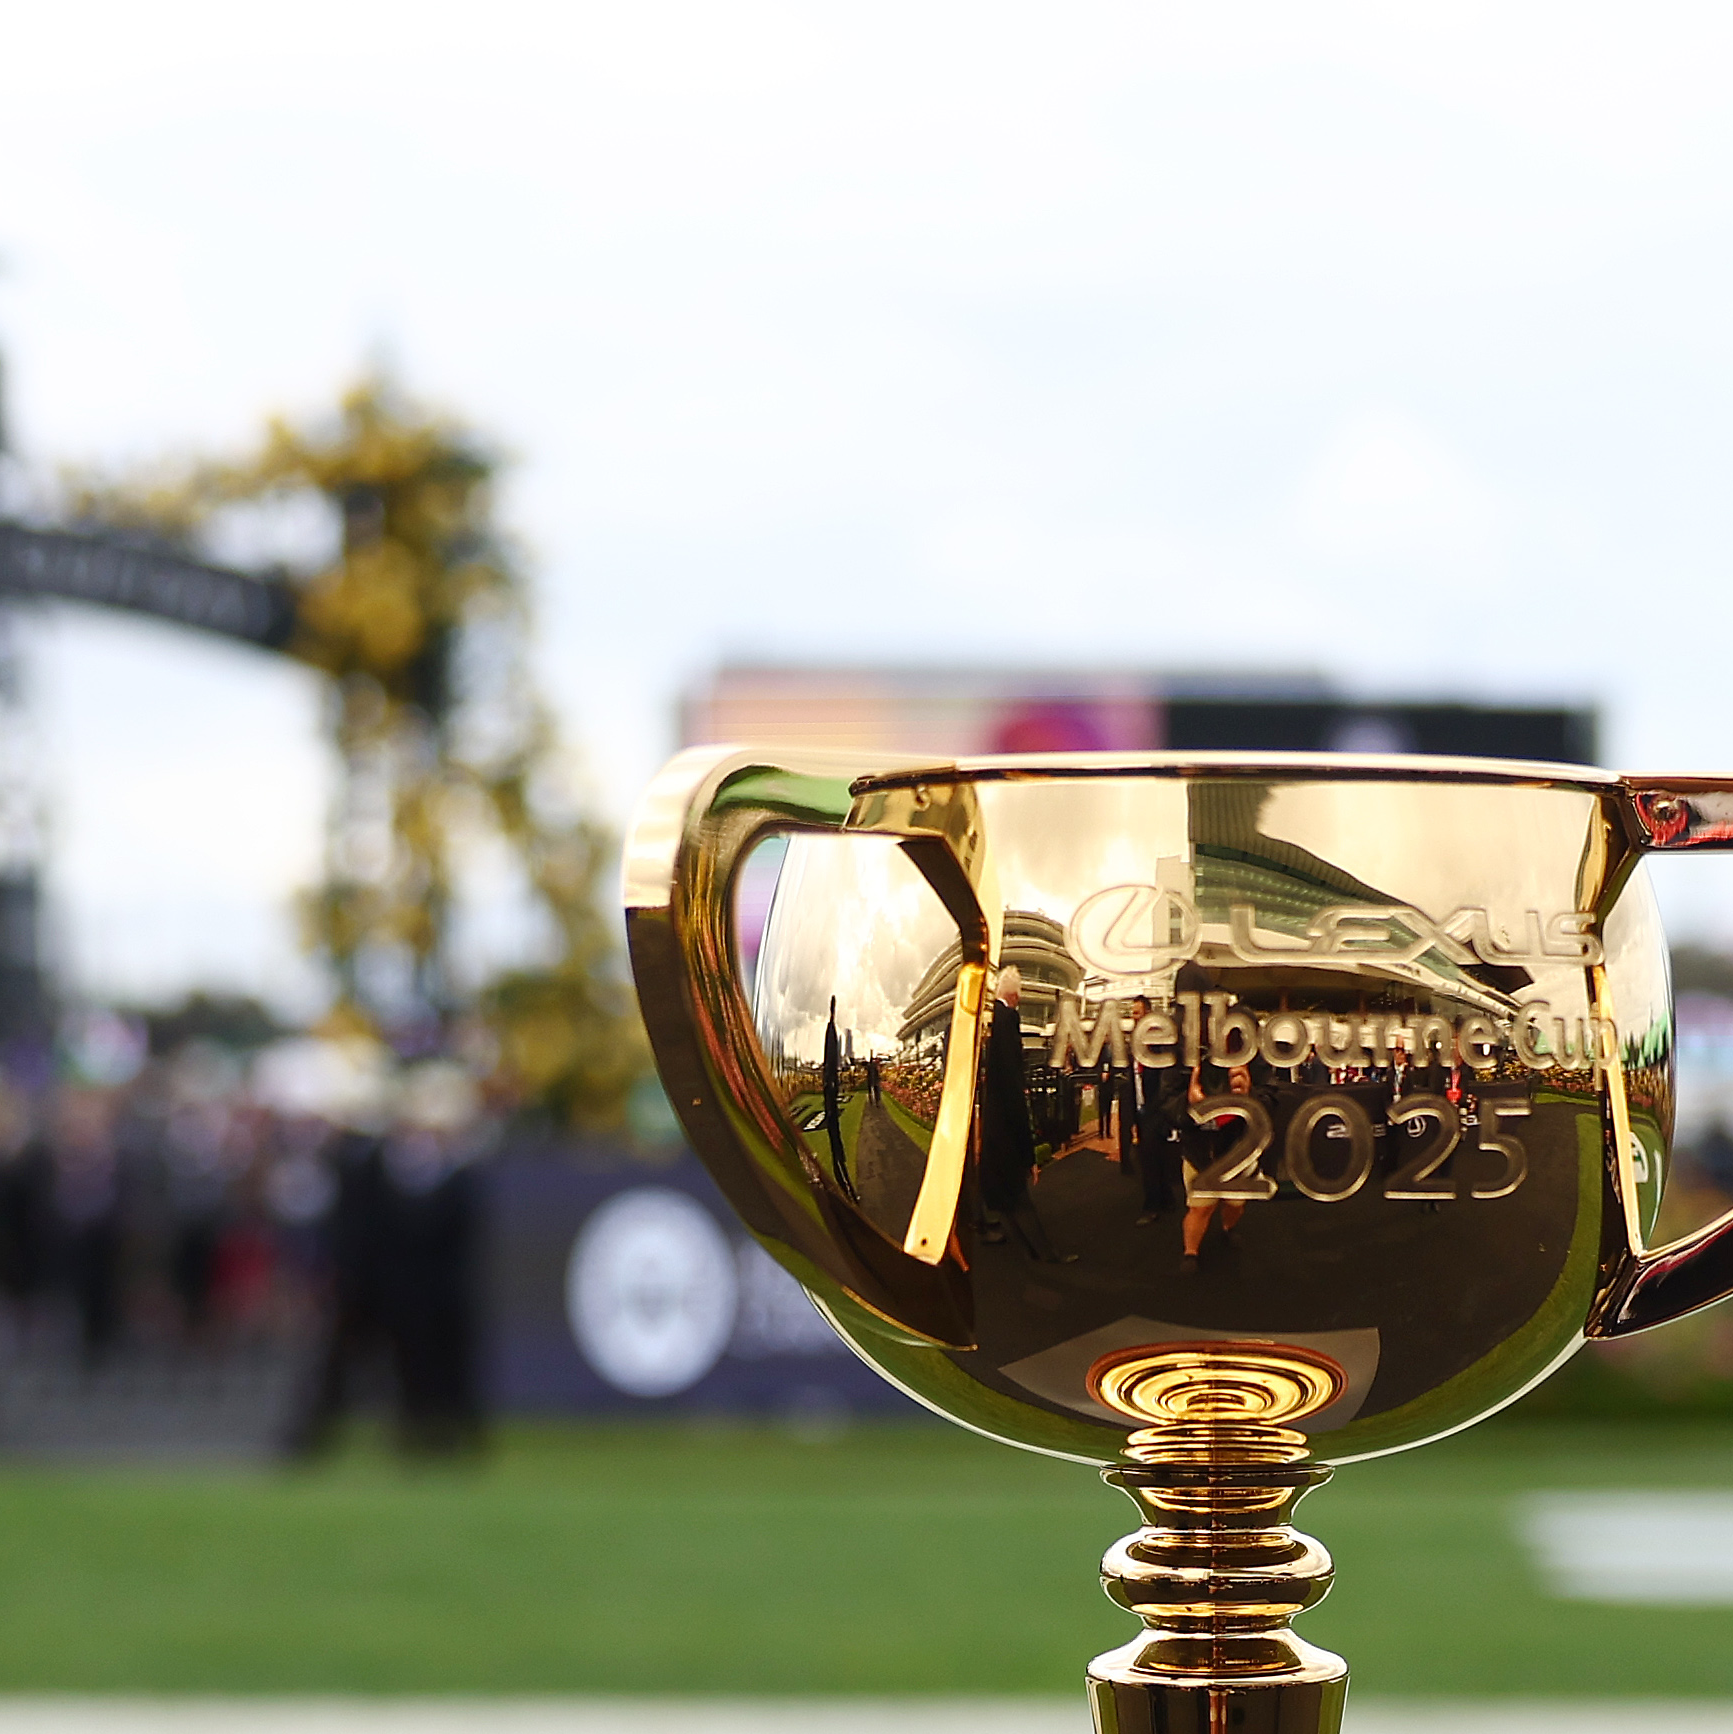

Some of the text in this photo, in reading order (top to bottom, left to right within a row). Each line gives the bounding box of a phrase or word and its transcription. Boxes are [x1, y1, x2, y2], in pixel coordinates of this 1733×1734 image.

[1229, 904, 1606, 967] LEXUS
[1048, 992, 1616, 1091] Melbourne Cup
[1187, 1093, 1533, 1202] 2025
